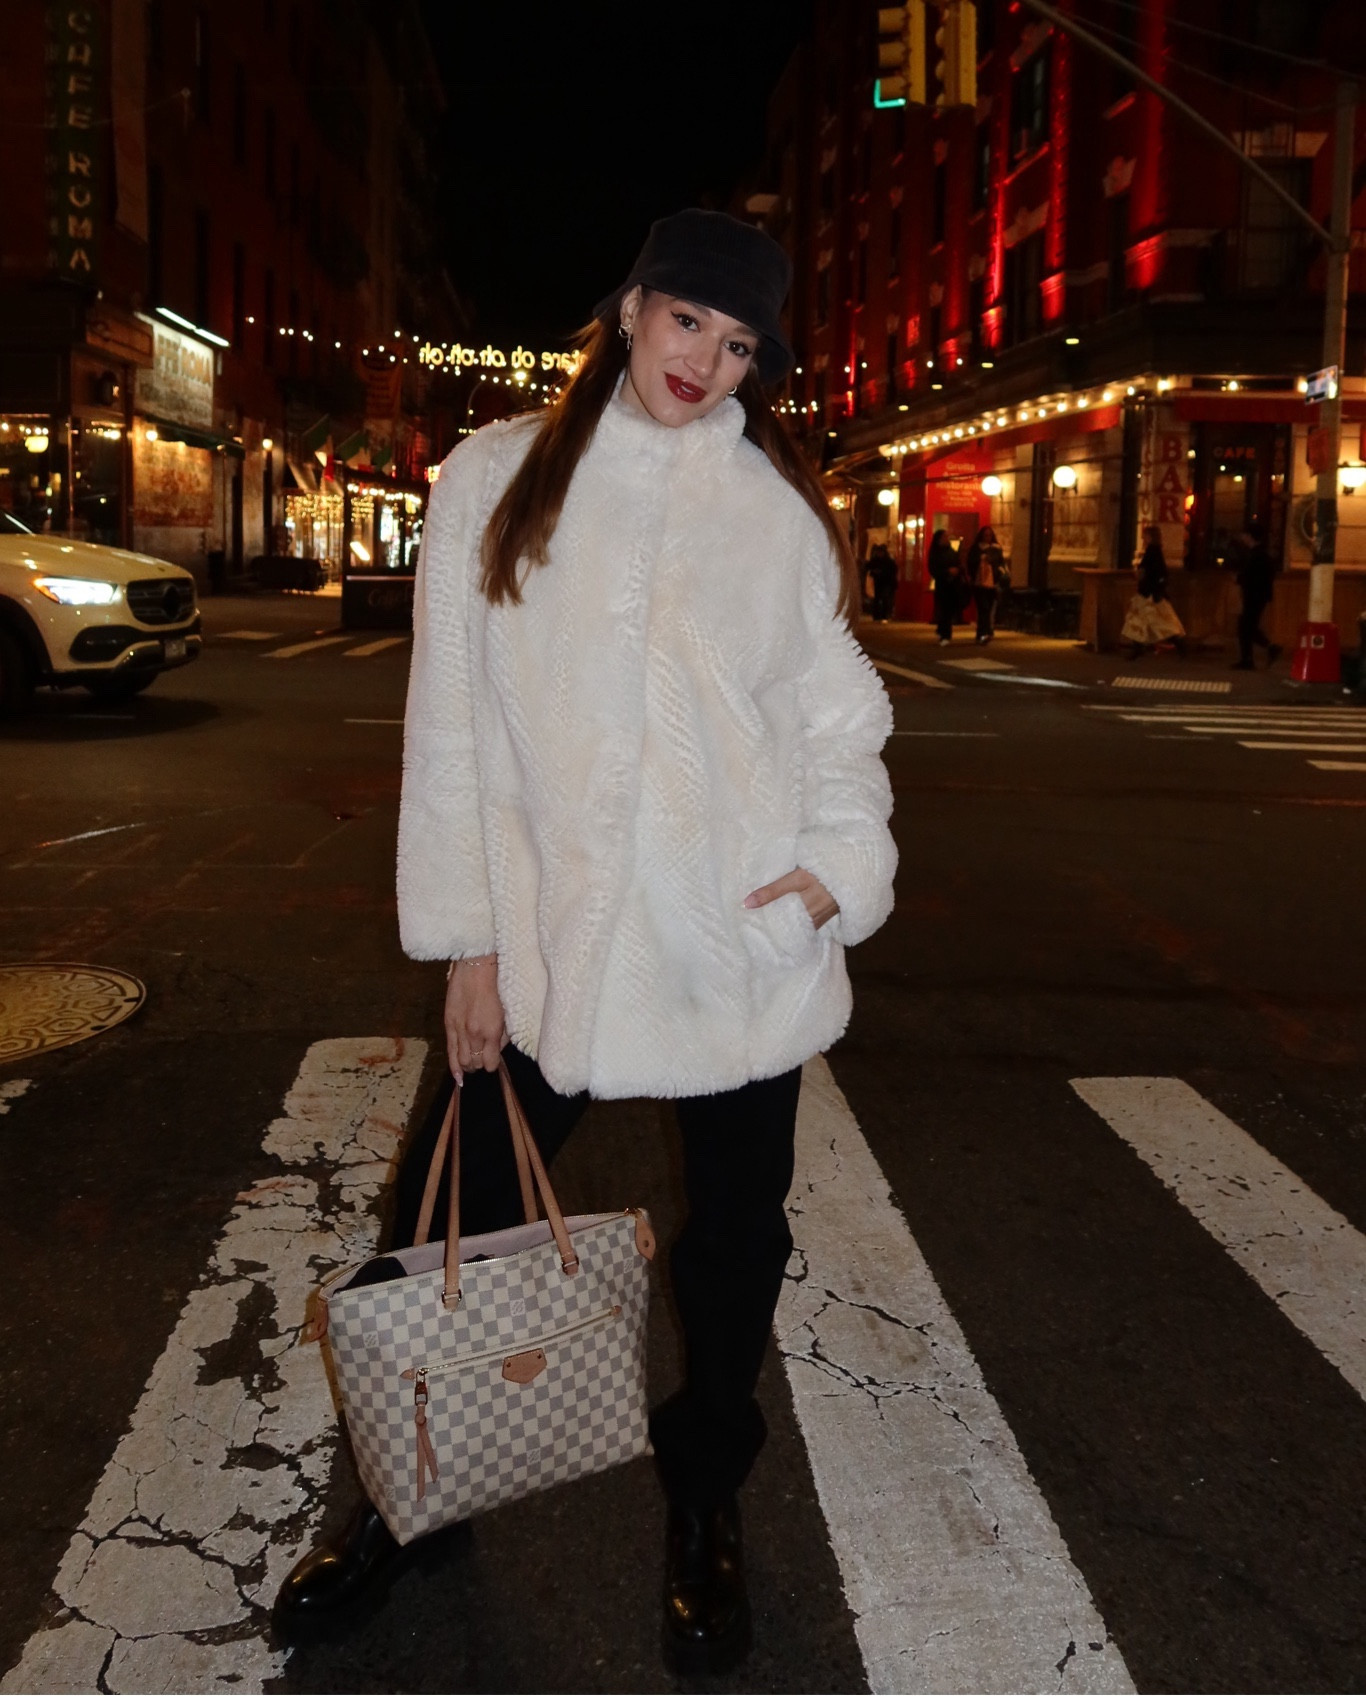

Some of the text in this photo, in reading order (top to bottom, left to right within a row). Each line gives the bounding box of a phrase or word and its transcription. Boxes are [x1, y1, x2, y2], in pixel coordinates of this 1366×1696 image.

[67, 150, 93, 272] ROMA
[1157, 433, 1184, 523] BAR
[1212, 446, 1256, 460] CAFE
